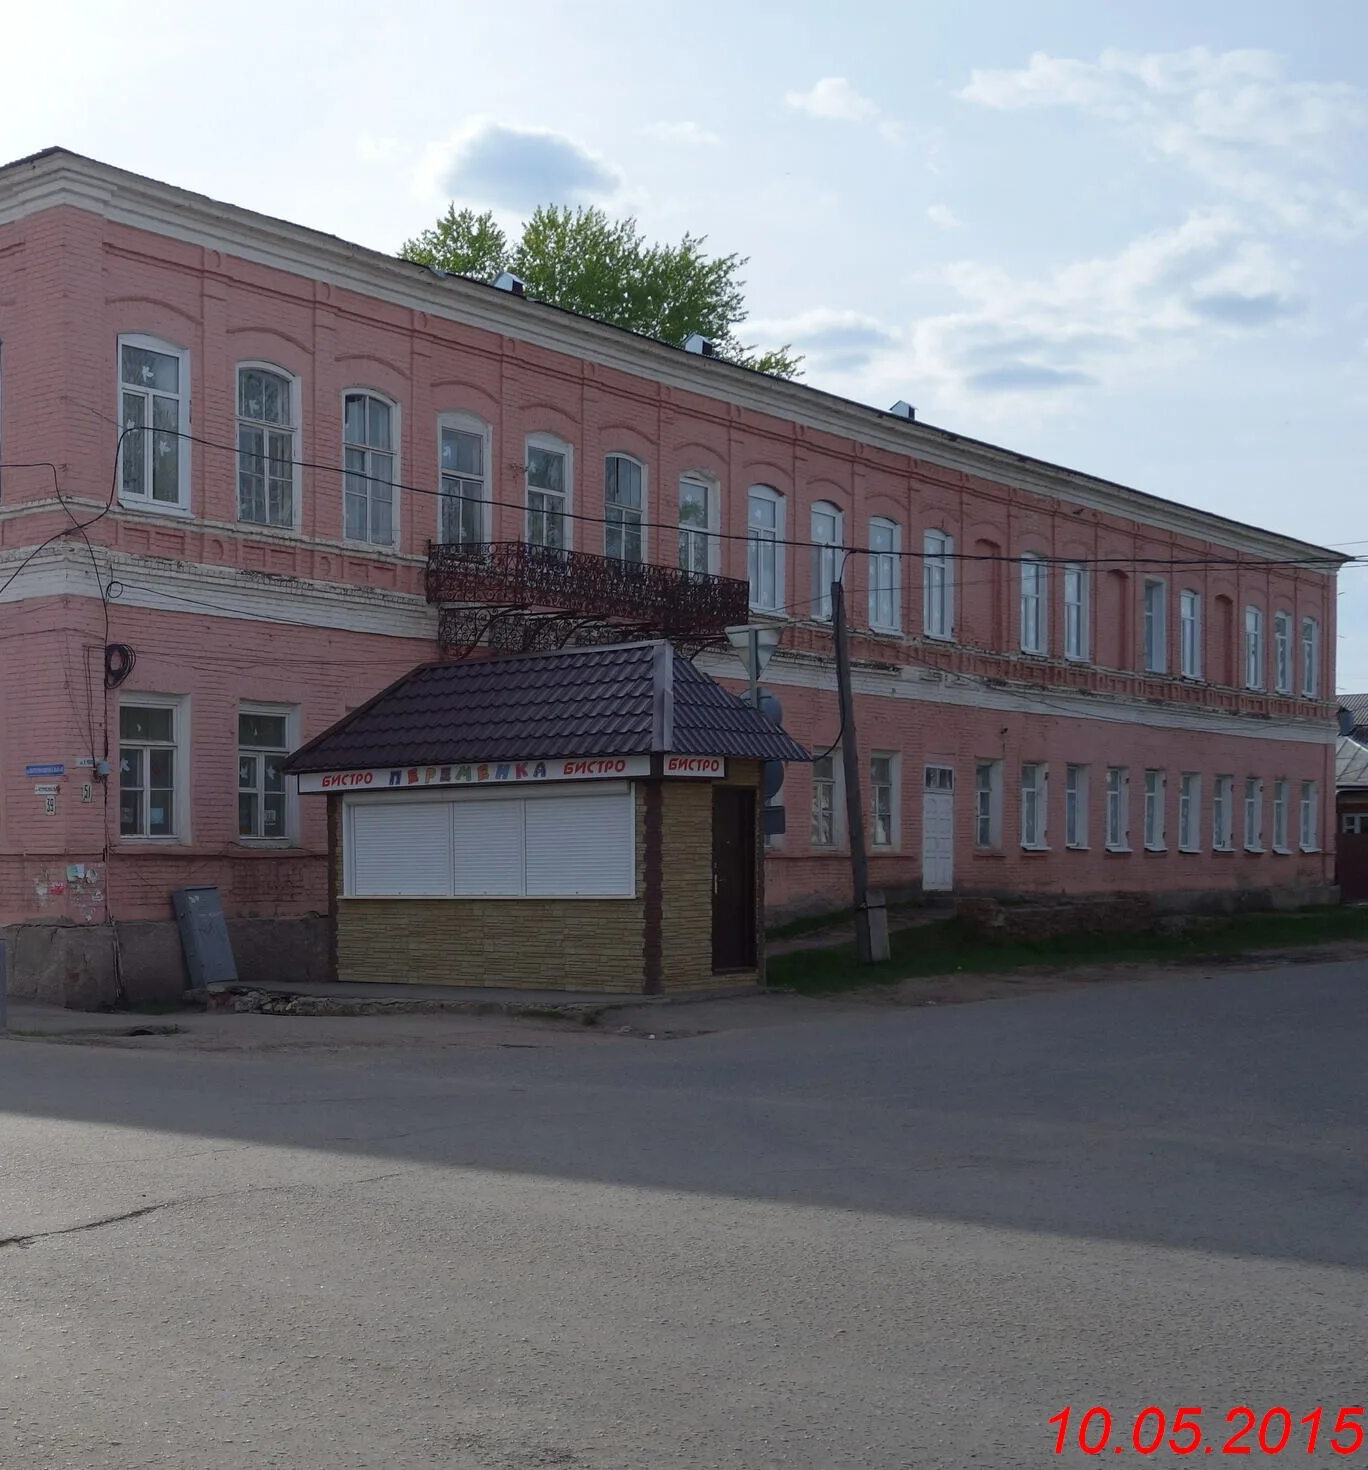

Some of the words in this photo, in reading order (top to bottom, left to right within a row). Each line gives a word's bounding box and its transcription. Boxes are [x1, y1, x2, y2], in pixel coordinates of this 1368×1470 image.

[322, 772, 373, 788] БИСТРО
[563, 759, 626, 775] БИСТРО
[668, 758, 720, 772] БИСТРО
